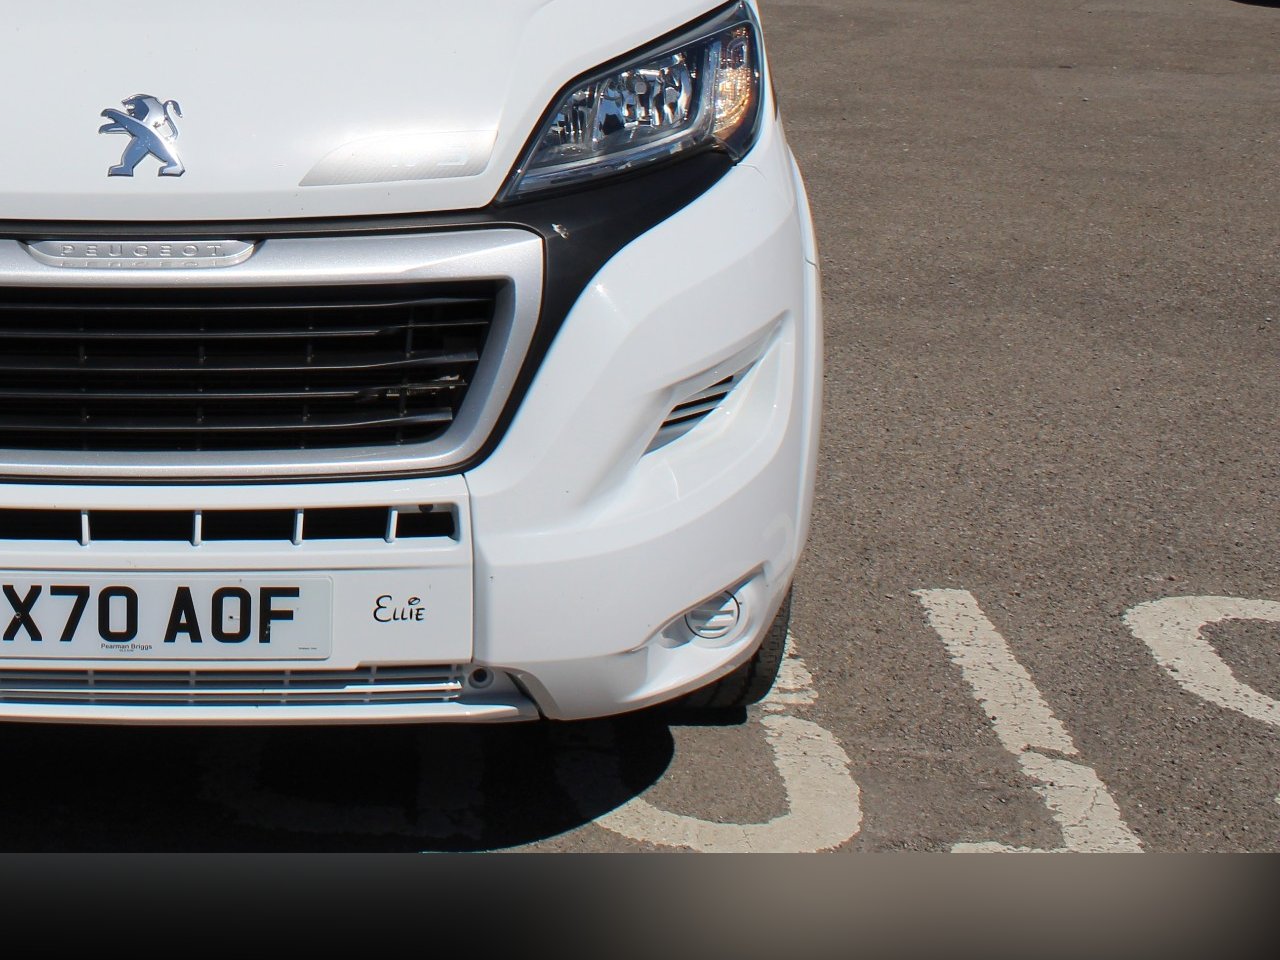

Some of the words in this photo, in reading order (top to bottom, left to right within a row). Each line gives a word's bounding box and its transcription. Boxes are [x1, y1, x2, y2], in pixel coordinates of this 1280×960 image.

[60, 244, 222, 257] PEUGEOT
[163, 586, 300, 644] AOF
[131, 643, 153, 651] Briggs
